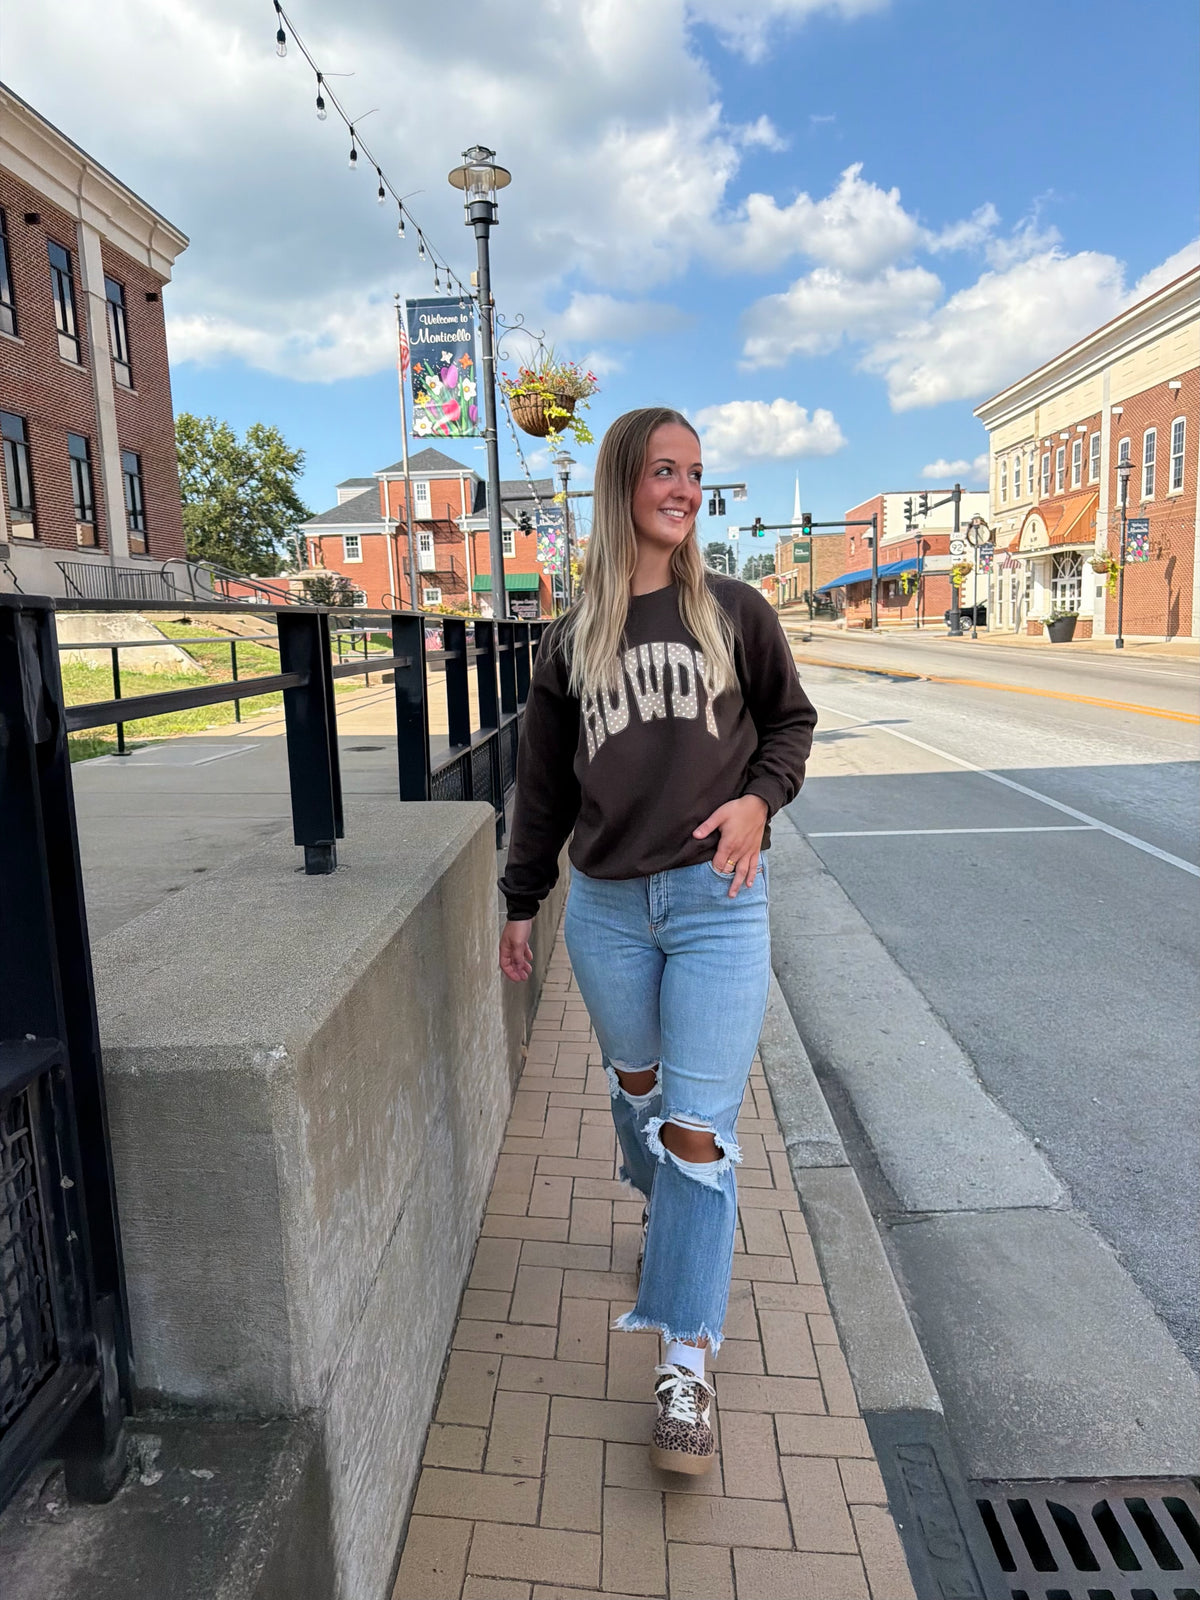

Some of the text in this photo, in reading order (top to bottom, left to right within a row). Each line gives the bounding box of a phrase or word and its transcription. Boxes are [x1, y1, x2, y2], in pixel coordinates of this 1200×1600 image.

[419, 313, 468, 325] Welcome to
[410, 327, 471, 345] Monticello
[951, 543, 963, 552] 92
